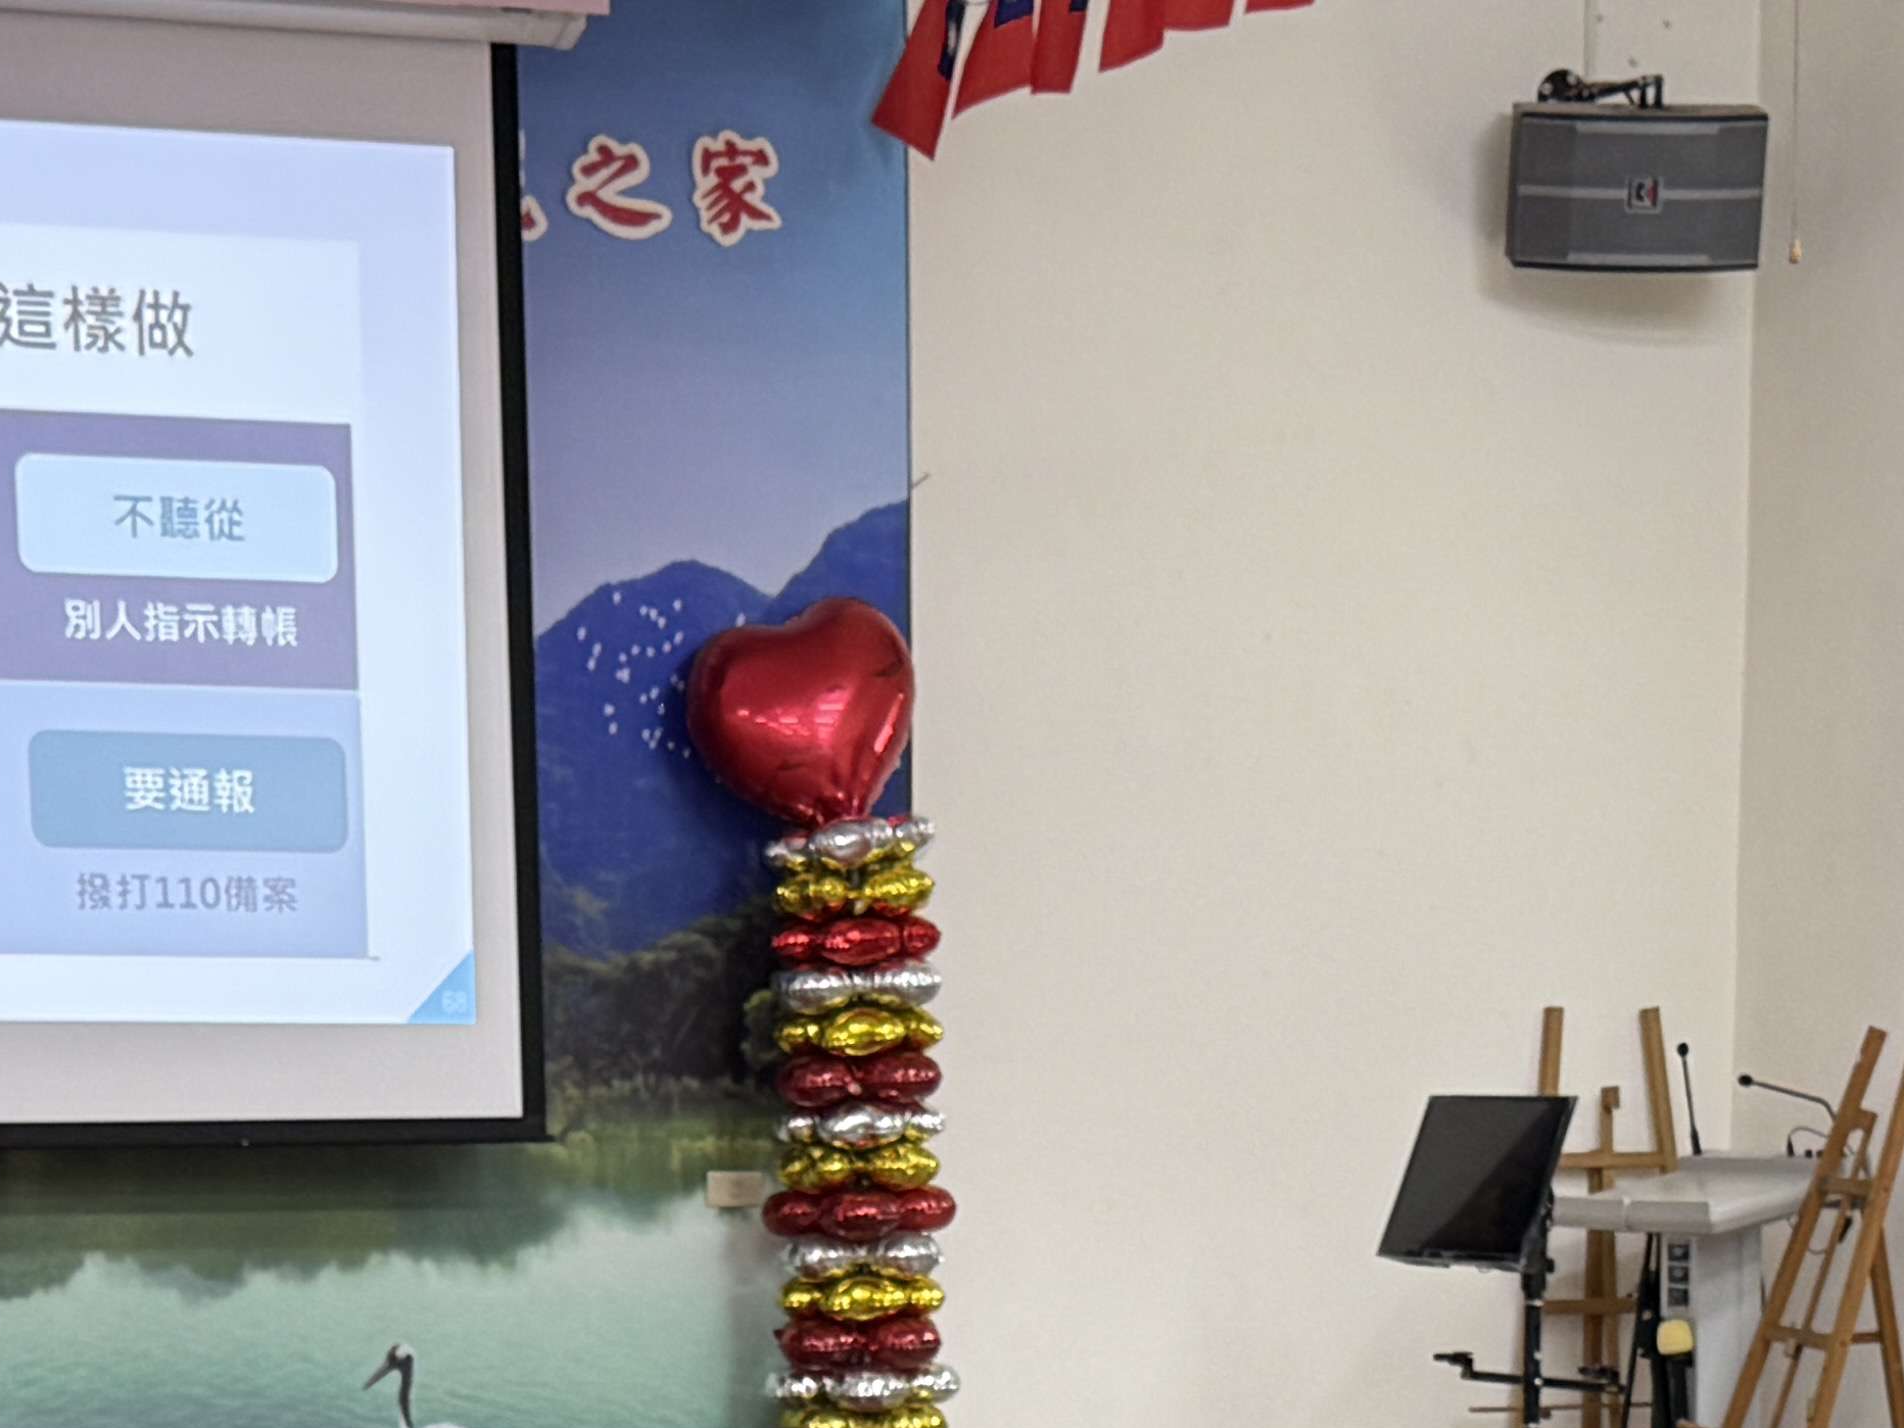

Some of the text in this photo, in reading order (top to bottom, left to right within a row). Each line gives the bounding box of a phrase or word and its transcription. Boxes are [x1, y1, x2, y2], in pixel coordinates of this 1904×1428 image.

[112, 492, 246, 545] 不聽從
[64, 597, 299, 648] 別人指示轉帳
[123, 767, 256, 814] 要通報
[75, 872, 299, 916] 撥打110備案
